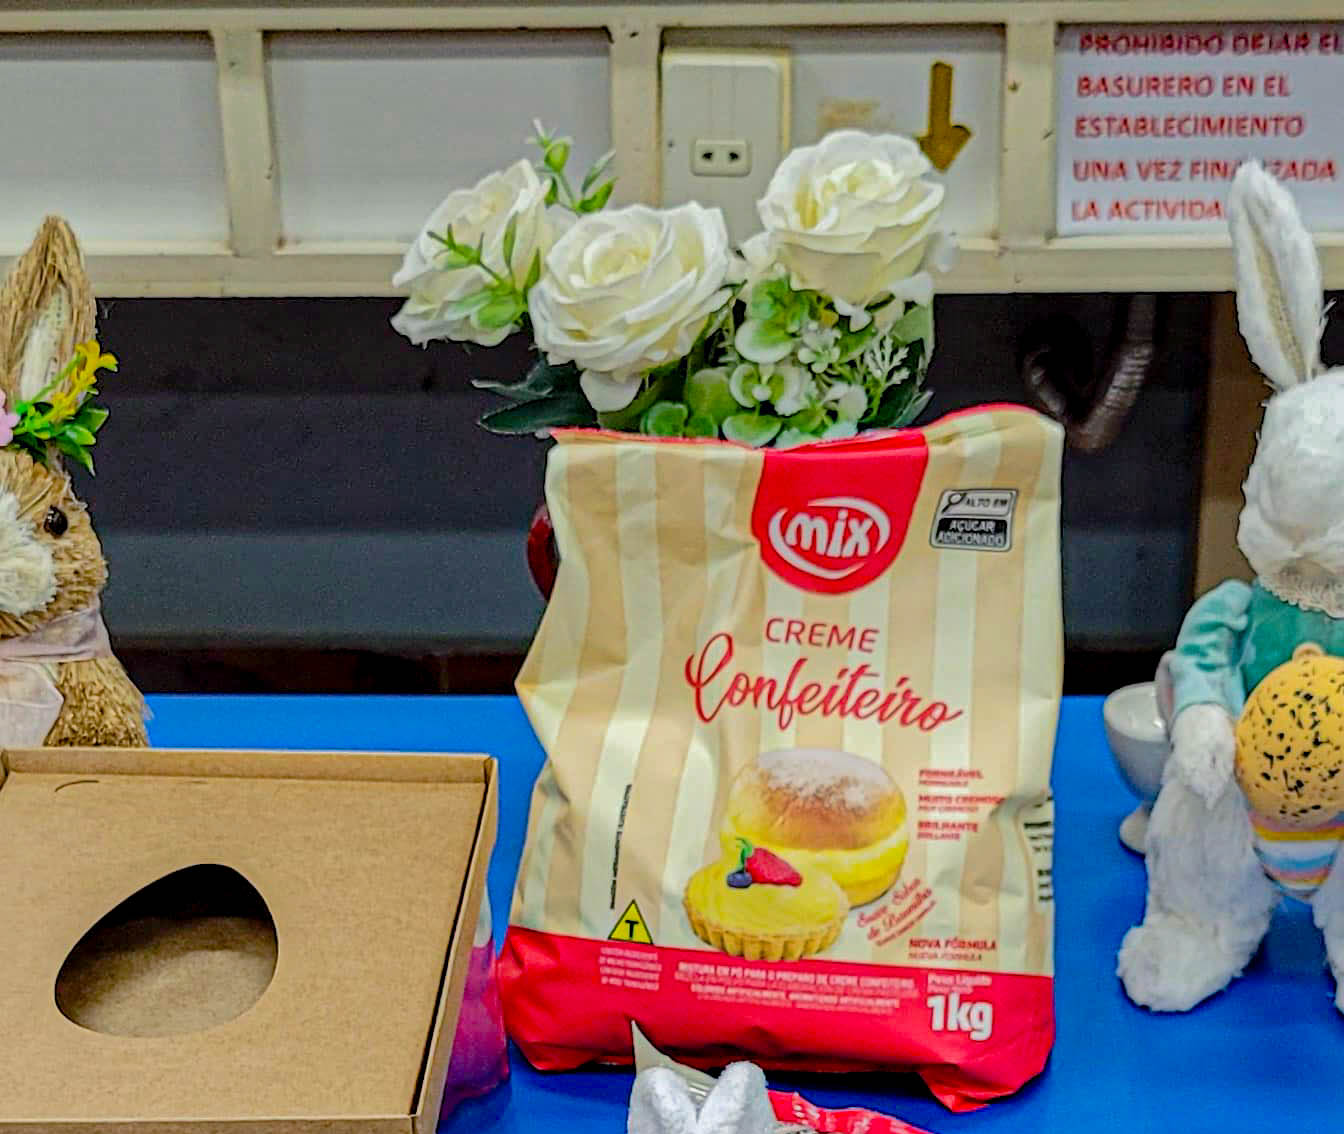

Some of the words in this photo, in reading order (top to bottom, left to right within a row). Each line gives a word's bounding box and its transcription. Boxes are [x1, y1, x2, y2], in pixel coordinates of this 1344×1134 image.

[1078, 32, 1224, 55] PROHIBIDO
[1232, 32, 1311, 55] DEJAR
[1318, 33, 1344, 55] EL
[1076, 76, 1215, 98] BASURERO
[1222, 76, 1255, 97] EN
[1263, 76, 1291, 97] EL
[1074, 114, 1305, 138] ESTABLECIMIENTO
[1072, 159, 1128, 182] UNA
[1136, 159, 1182, 182] VEZ
[1189, 159, 1338, 182] FINAZADA
[1070, 200, 1099, 222] LA
[1108, 199, 1228, 222] ACTIVIDA
[784, 508, 875, 558] mix
[765, 617, 880, 653] CREME
[684, 632, 963, 732] Confeiteiro
[918, 820, 979, 832] BRILHANTE
[625, 919, 639, 939] T
[909, 938, 941, 949] NOVA
[945, 937, 997, 950] FÓRMULA
[927, 992, 993, 1041] 1kg
